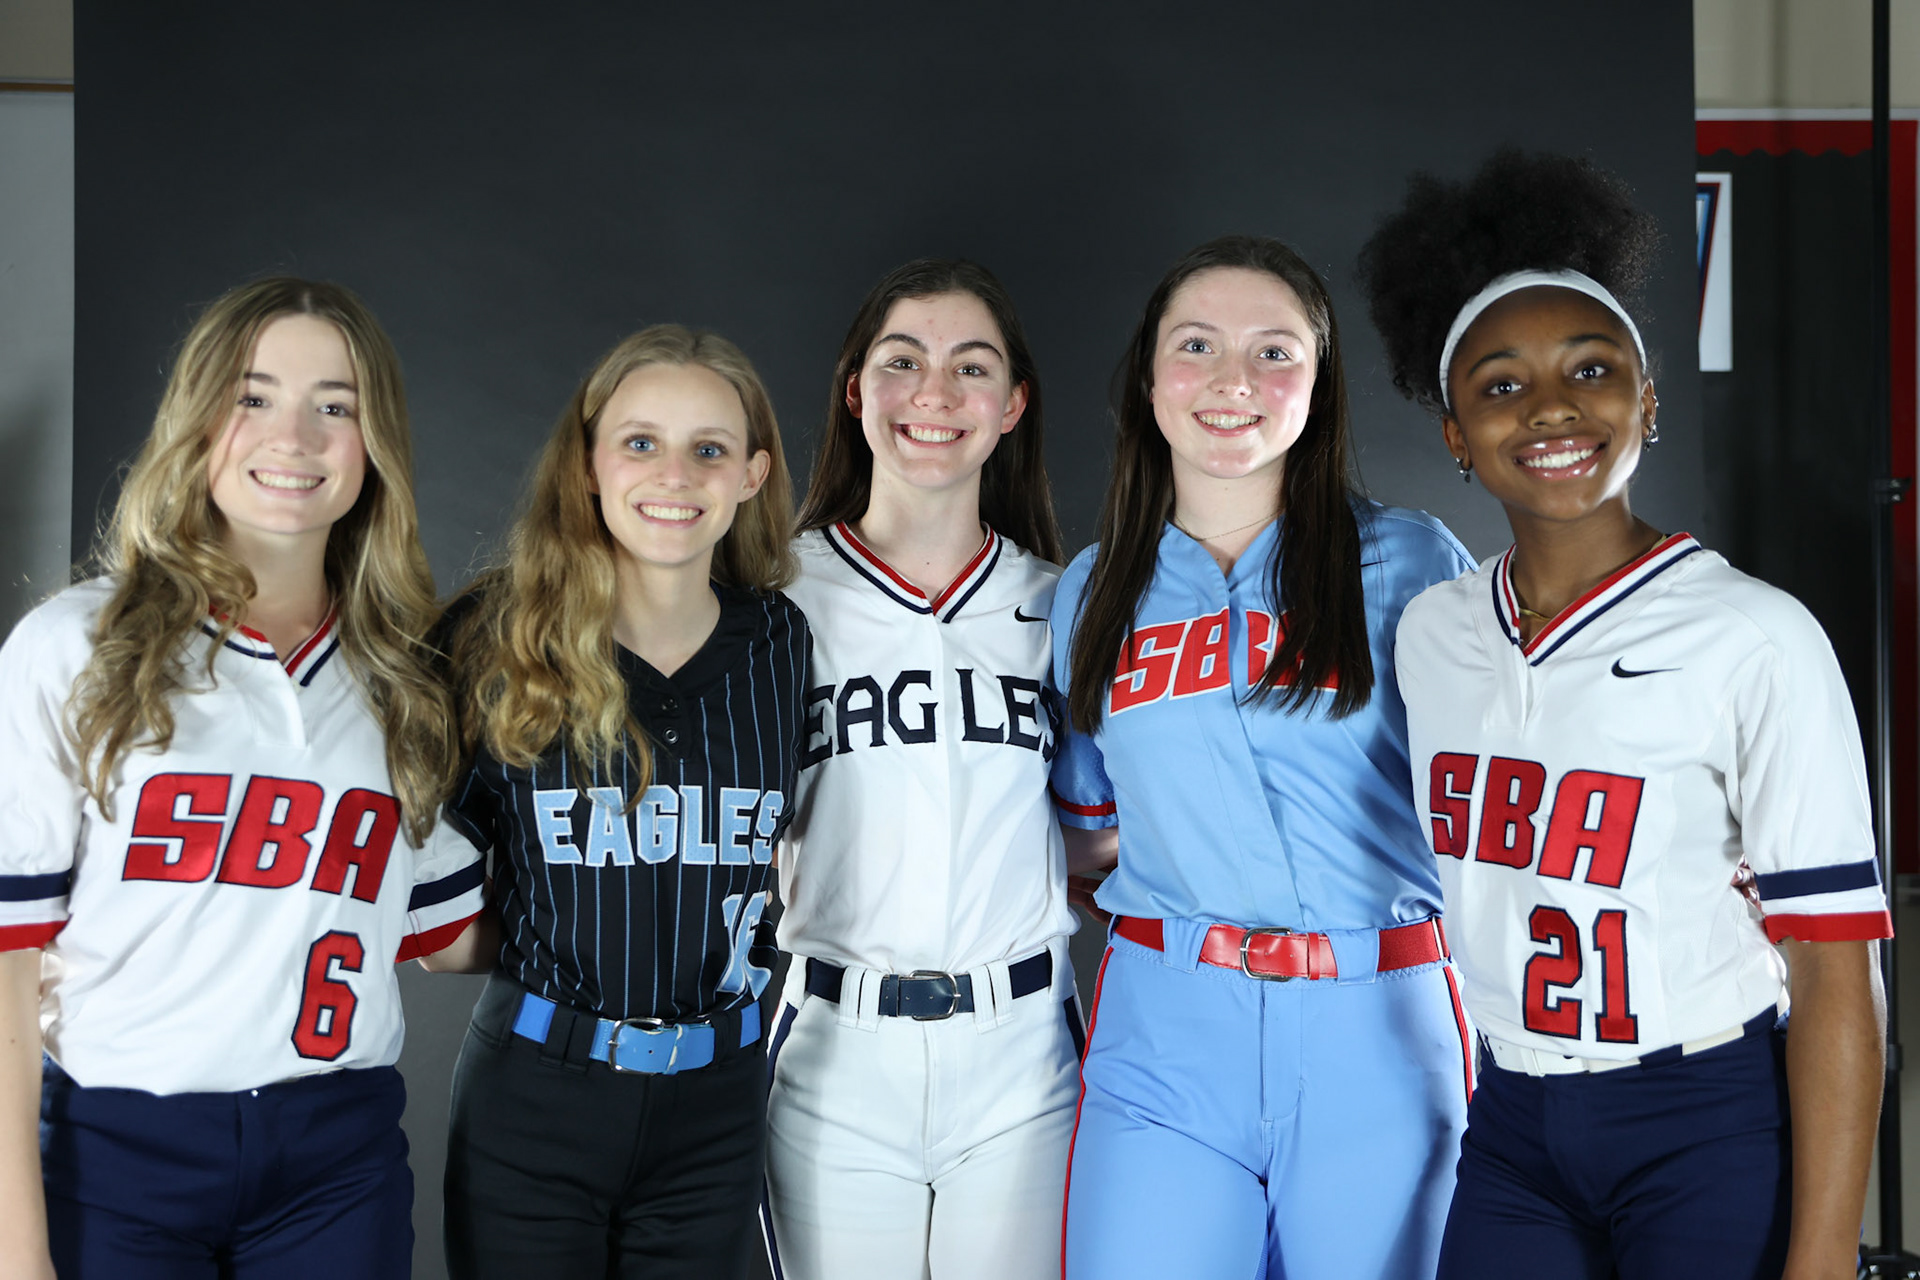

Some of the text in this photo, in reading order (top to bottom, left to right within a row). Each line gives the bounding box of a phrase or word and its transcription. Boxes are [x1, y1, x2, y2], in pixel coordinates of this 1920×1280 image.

[122, 772, 401, 903] SBA
[532, 784, 784, 867] EAGLES
[1430, 751, 1645, 889] SBA
[291, 930, 365, 1061] 6
[1522, 904, 1639, 1044] 21
